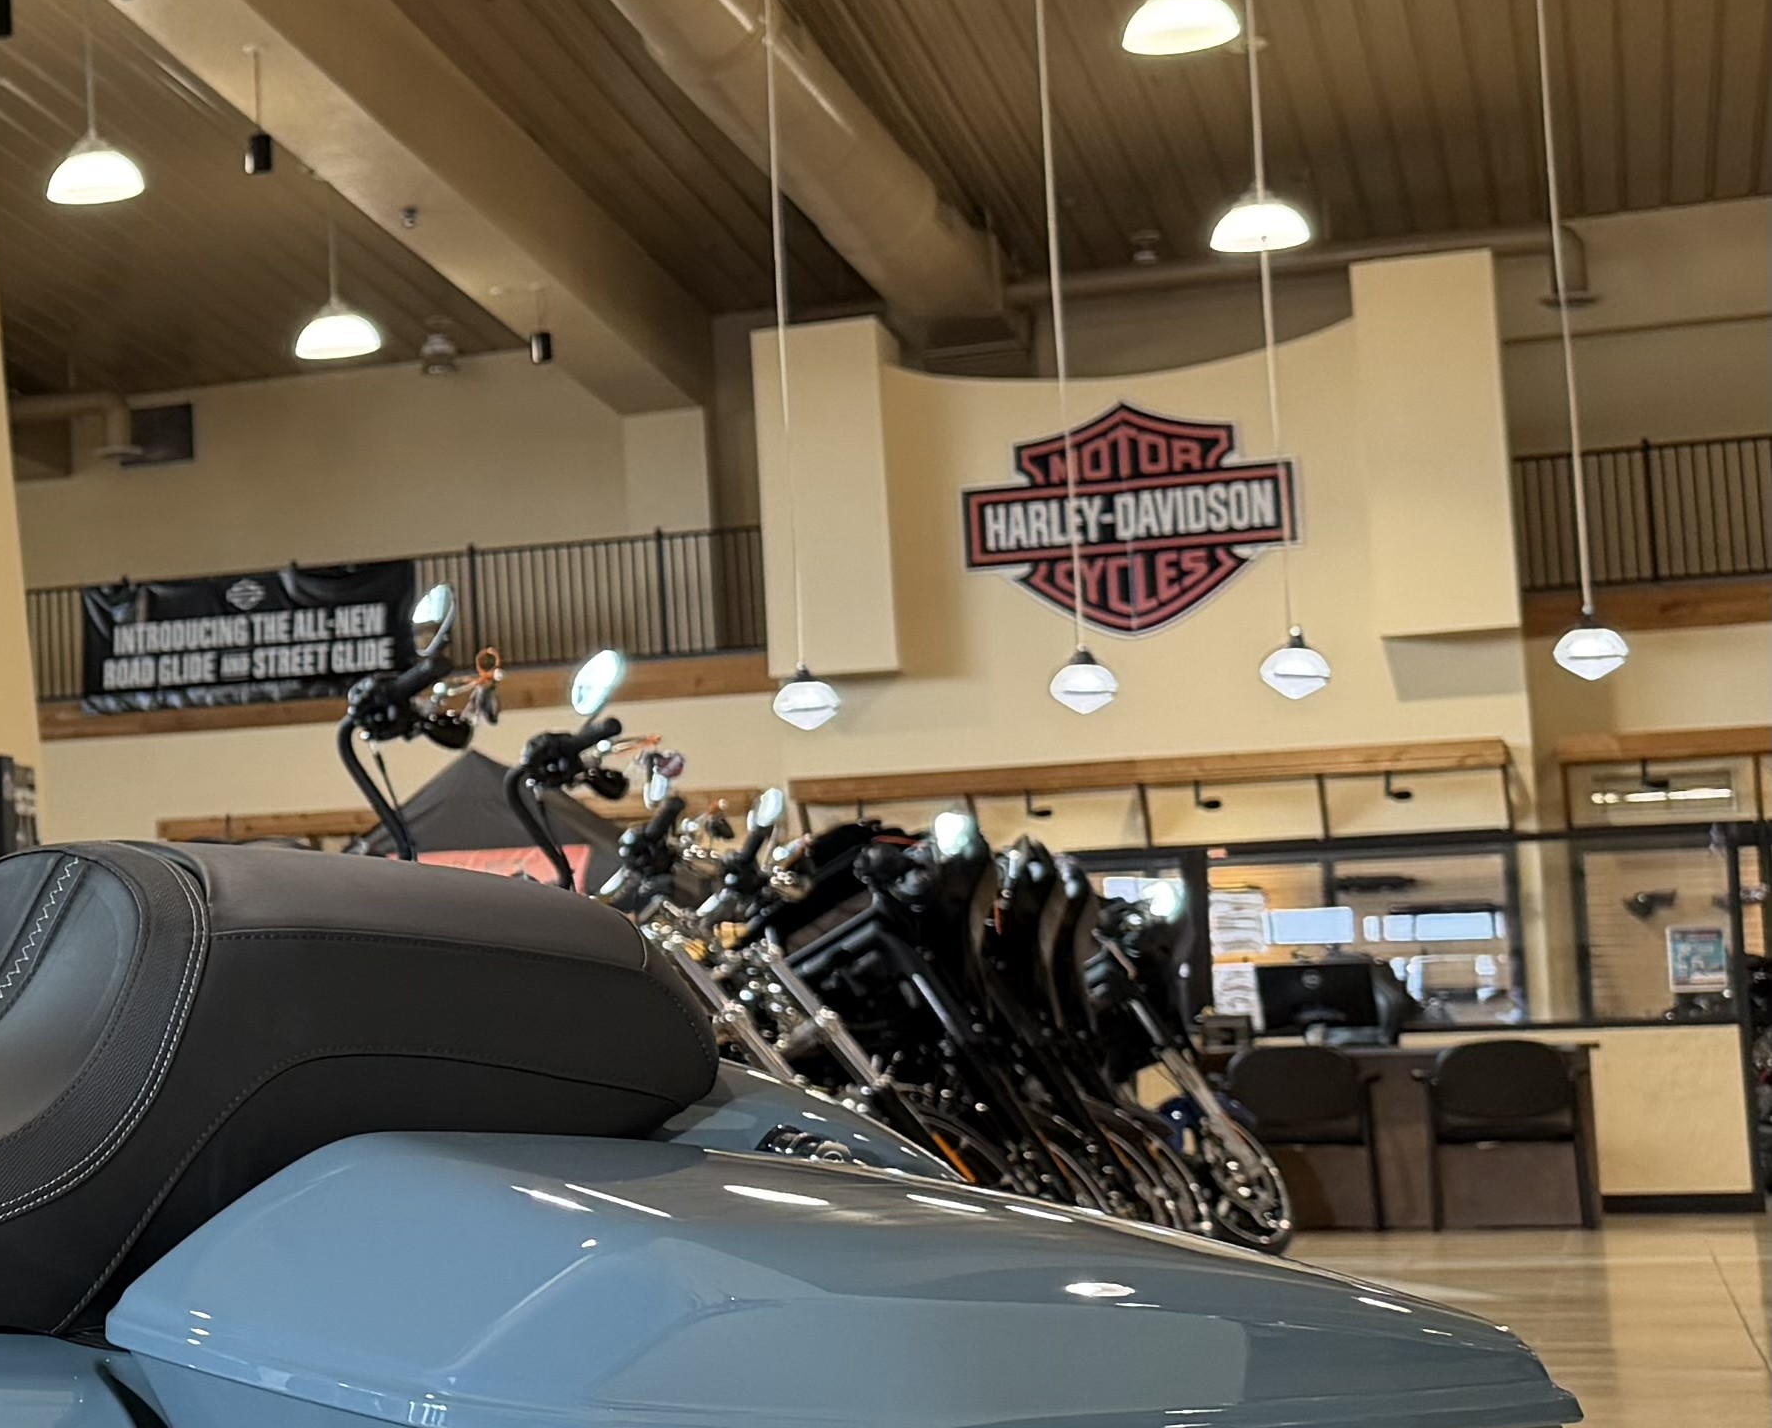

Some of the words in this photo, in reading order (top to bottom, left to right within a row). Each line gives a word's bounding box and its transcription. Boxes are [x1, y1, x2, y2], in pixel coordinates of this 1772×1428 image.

[1049, 423, 1203, 485] MOTOR
[984, 478, 1278, 552] HARLEY-DAVIDSON
[1054, 547, 1210, 616] CYCLES
[113, 614, 250, 657] INTRODUCING
[251, 610, 292, 645] THE
[293, 602, 388, 641] ALL-NEW
[103, 656, 157, 691] ROAD
[158, 652, 219, 686] GLIDE
[252, 642, 330, 679] STREET
[331, 637, 395, 673] GLIDE
